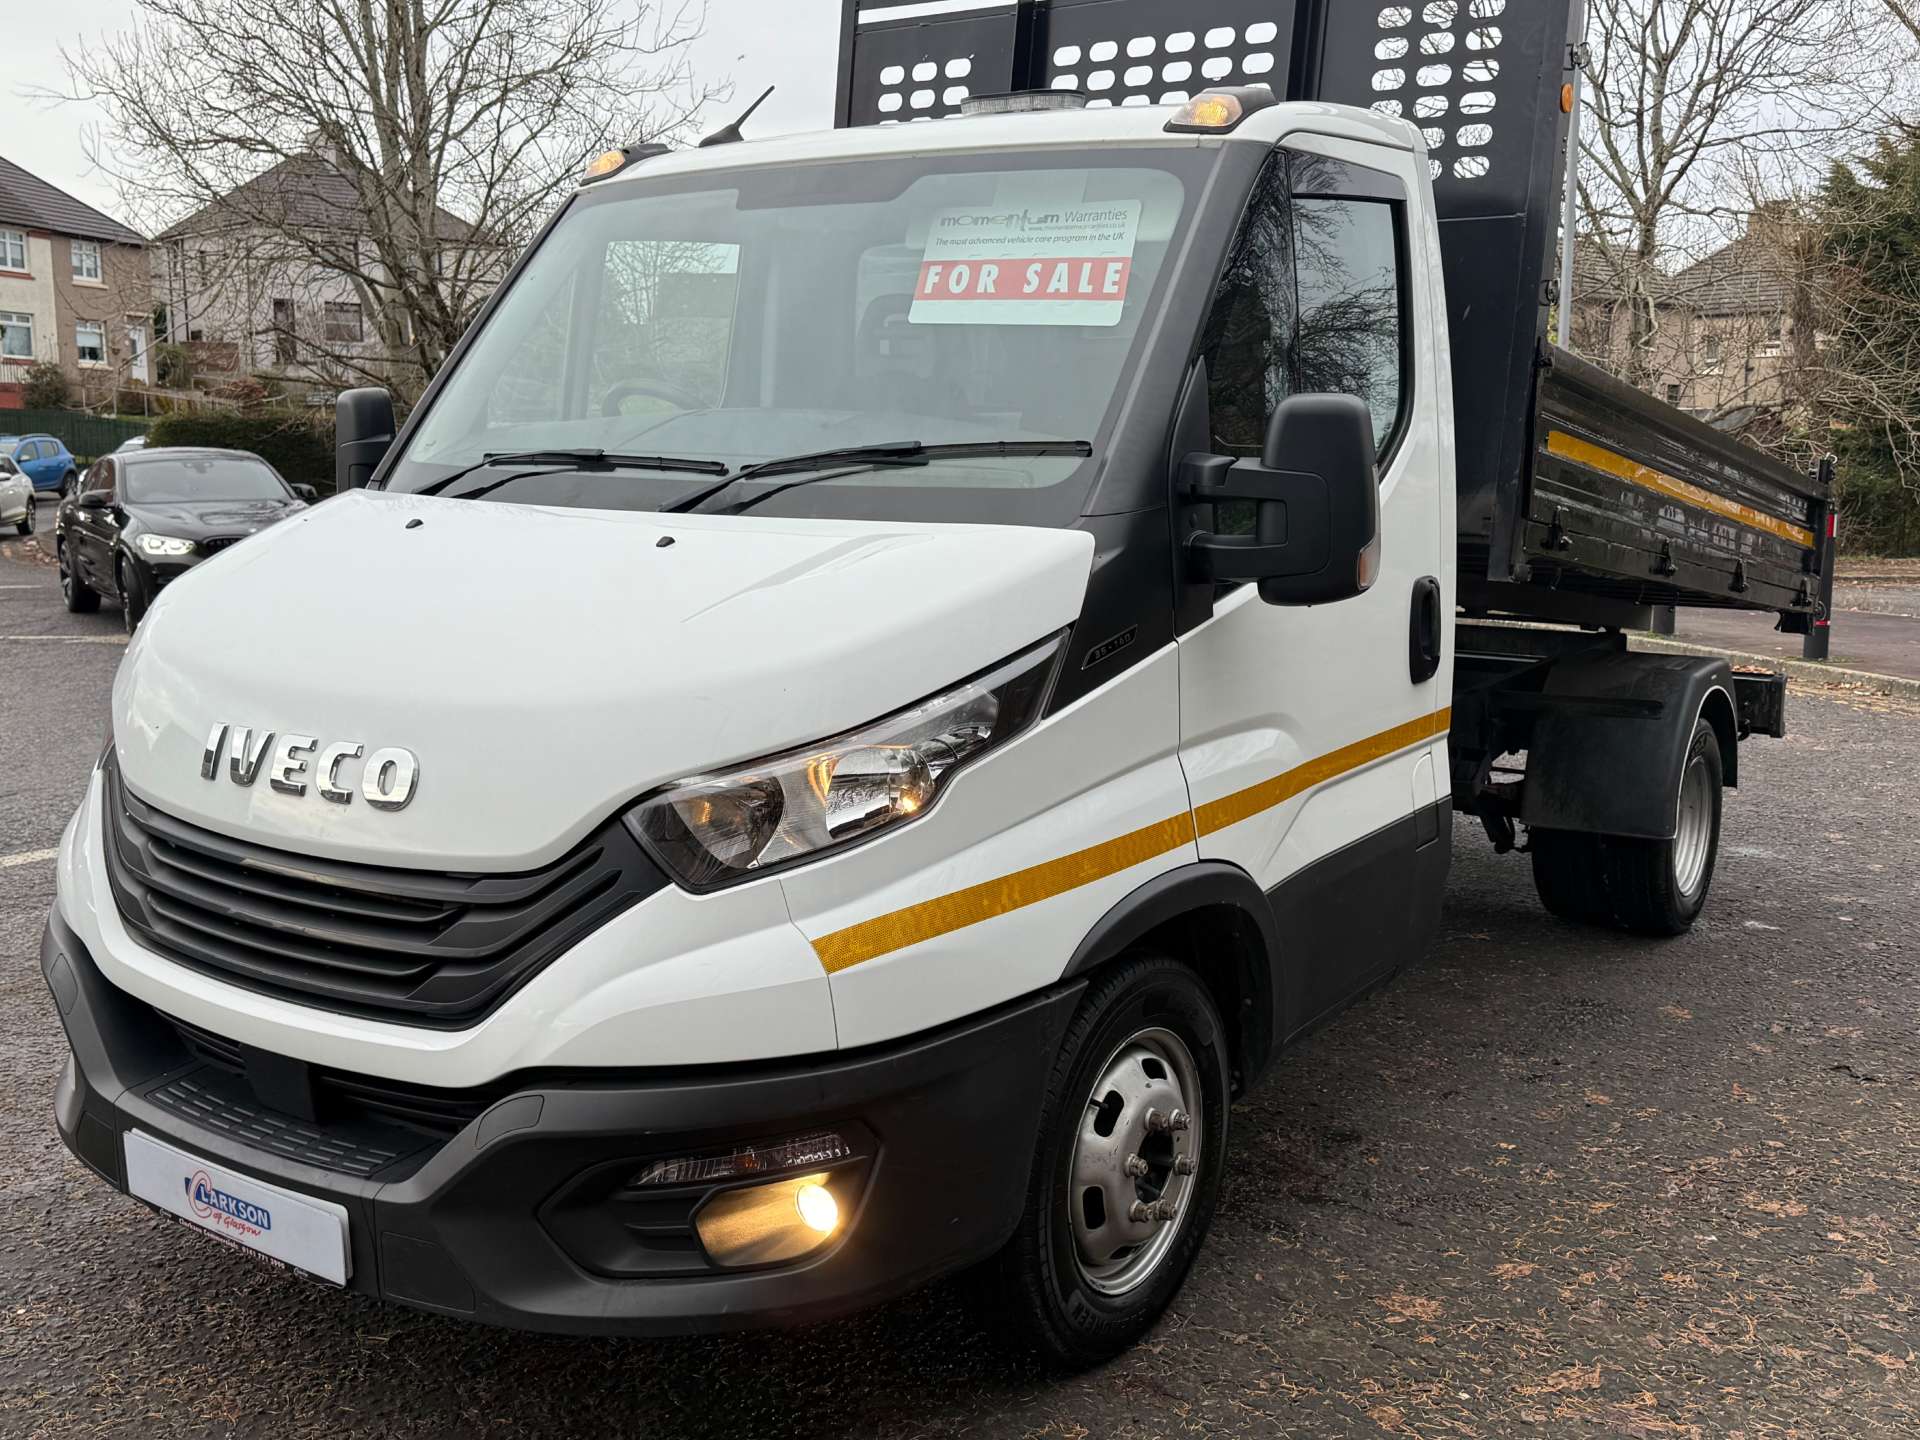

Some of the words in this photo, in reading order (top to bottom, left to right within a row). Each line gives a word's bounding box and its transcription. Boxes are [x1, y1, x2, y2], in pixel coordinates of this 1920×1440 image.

[940, 208, 1060, 232] momentum
[1064, 208, 1128, 224] Warranties
[936, 237, 949, 247] The
[949, 238, 967, 247] most
[968, 236, 1006, 246] advanced
[1007, 234, 1034, 245] vehicle
[1034, 235, 1052, 244] care
[1053, 234, 1088, 245] program
[1089, 233, 1096, 242] in
[1097, 232, 1111, 241] the
[1112, 231, 1125, 241] UK
[924, 264, 999, 294] FOR
[1023, 262, 1123, 294] SALE
[200, 720, 420, 812] IVECO
[188, 1170, 270, 1229] CLARKSON
[213, 1212, 223, 1225] of
[223, 1216, 262, 1237] Glasgow
